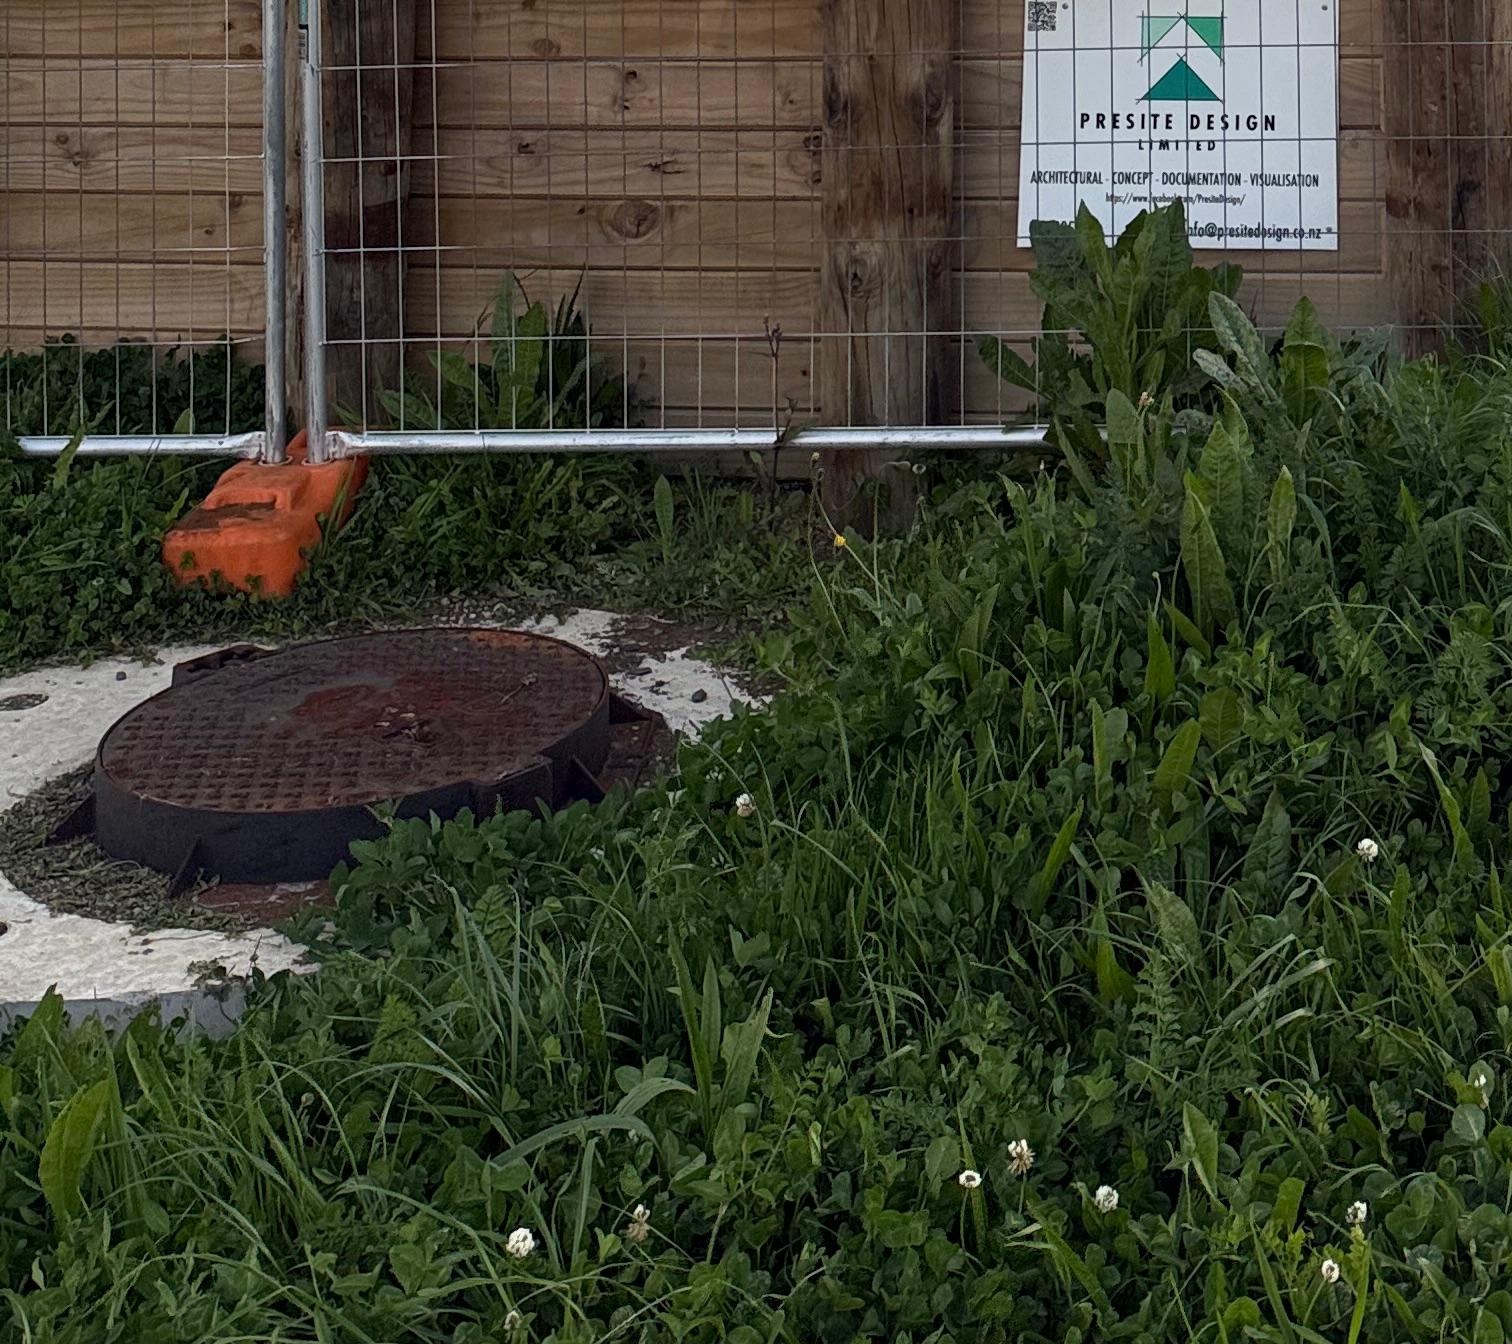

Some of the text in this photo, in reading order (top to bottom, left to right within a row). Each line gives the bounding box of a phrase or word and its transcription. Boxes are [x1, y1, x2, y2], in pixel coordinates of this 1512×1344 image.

[1080, 113, 1276, 131] PRESITE DESIGN
[1162, 172, 1241, 186] DOCUMENTATON
